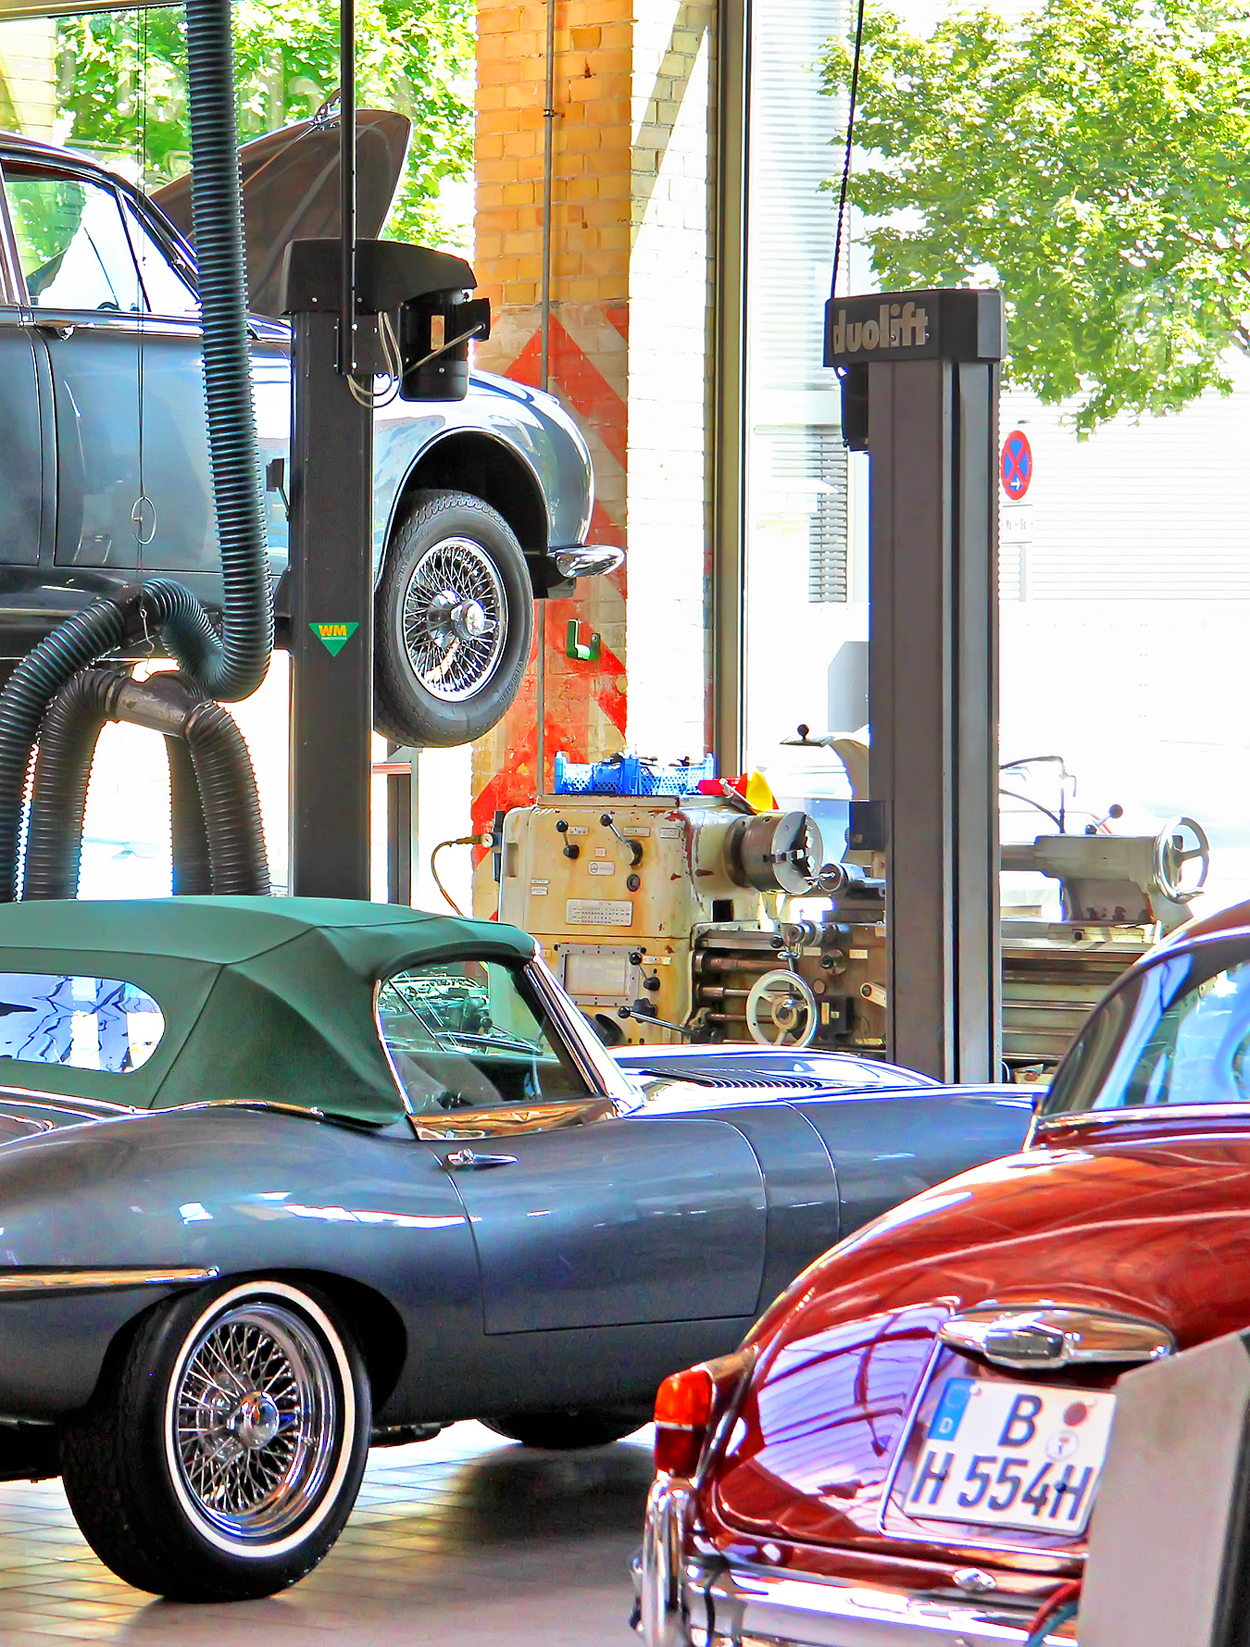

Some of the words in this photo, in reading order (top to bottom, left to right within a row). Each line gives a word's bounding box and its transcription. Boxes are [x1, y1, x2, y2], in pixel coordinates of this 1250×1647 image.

[833, 301, 928, 354] duolift
[318, 625, 347, 636] WM
[997, 1393, 1042, 1447] B
[910, 1450, 955, 1505] H
[957, 1454, 1094, 1521] 554H
